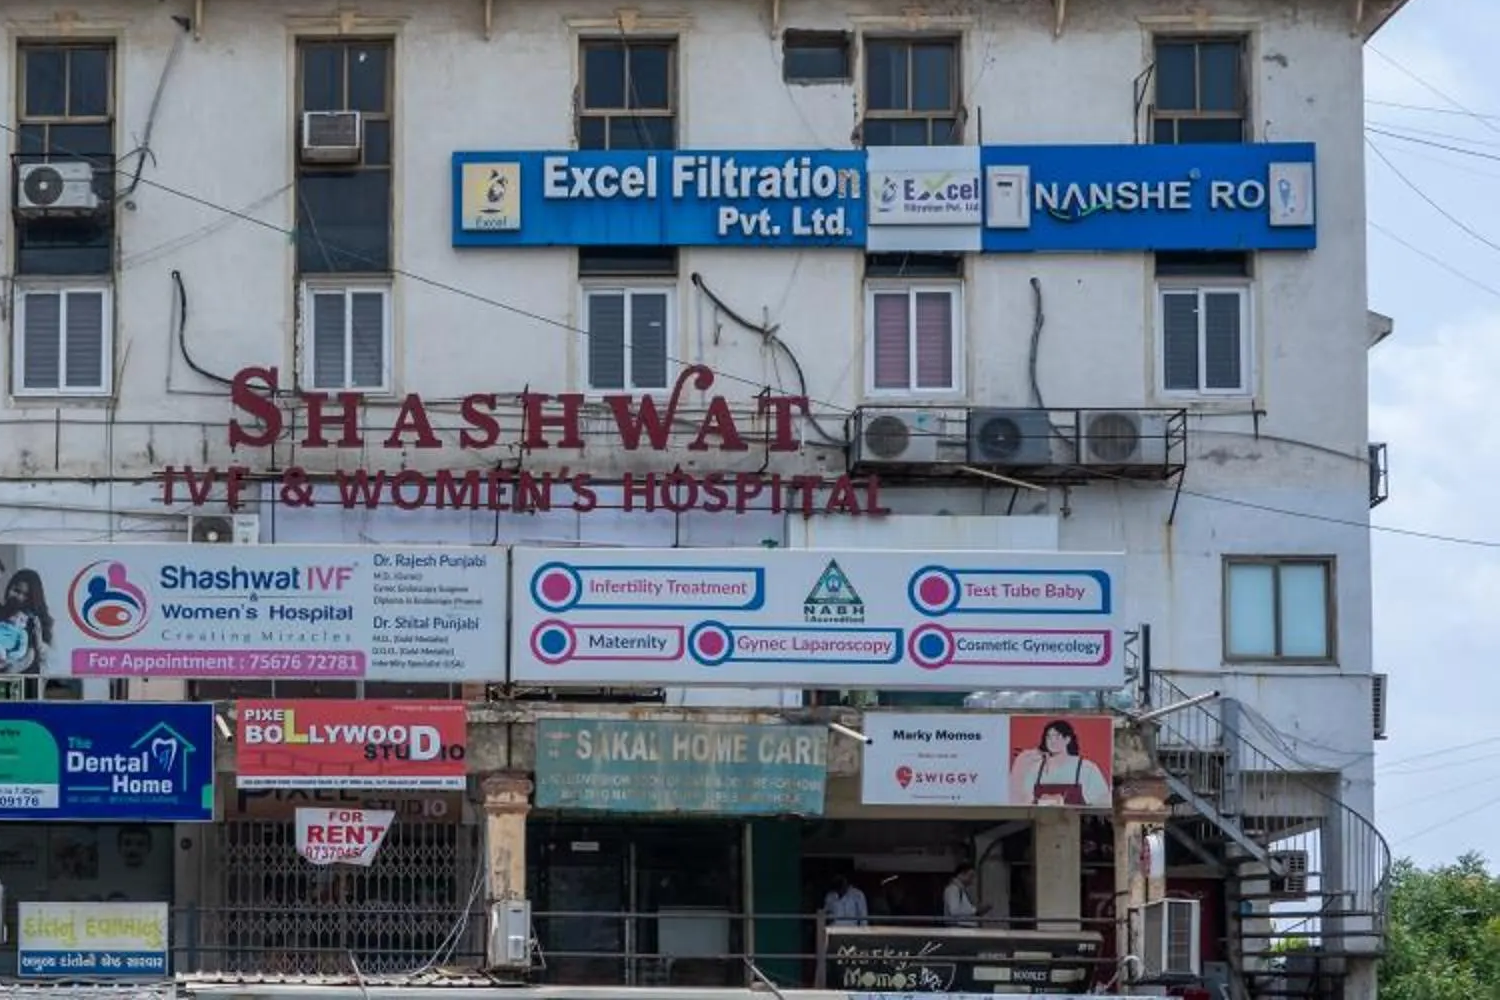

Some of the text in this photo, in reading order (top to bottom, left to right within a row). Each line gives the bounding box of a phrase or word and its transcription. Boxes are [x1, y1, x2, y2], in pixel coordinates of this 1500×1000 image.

[543, 155, 861, 199] Excel Filtration
[1034, 180, 1265, 211] NANSHE RO
[717, 206, 853, 237] Pvt. Ltd.
[229, 364, 810, 453] SHASHWAT
[279, 464, 315, 509] &
[335, 466, 598, 514] WOMEN'S
[623, 470, 891, 518] HOSPITAL
[372, 553, 393, 567] Dr.
[160, 564, 354, 591] Shashwat IVF
[589, 578, 748, 597] Infertility Treatment
[965, 584, 1086, 600] Test Tube Baby
[161, 603, 354, 624] Women's Hospital
[372, 615, 392, 629] Dr.
[433, 616, 480, 632] Punjabi
[161, 629, 352, 644] Creating Miracles
[588, 633, 668, 651] Maternity
[736, 635, 893, 654] Gynec Laparoscopy
[956, 637, 1102, 656] Cosmetic Gynecology
[87, 652, 115, 670] For
[119, 651, 235, 674] Appointment
[249, 654, 301, 670] 75676
[307, 654, 359, 670] 72781
[67, 736, 93, 749] The
[673, 732, 748, 763] HOME
[757, 735, 828, 766] CARE
[66, 751, 149, 773] Dental
[112, 774, 174, 794] Home
[915, 771, 979, 784] SWIGGY
[328, 811, 364, 823] FOR
[306, 825, 385, 844] RENT
